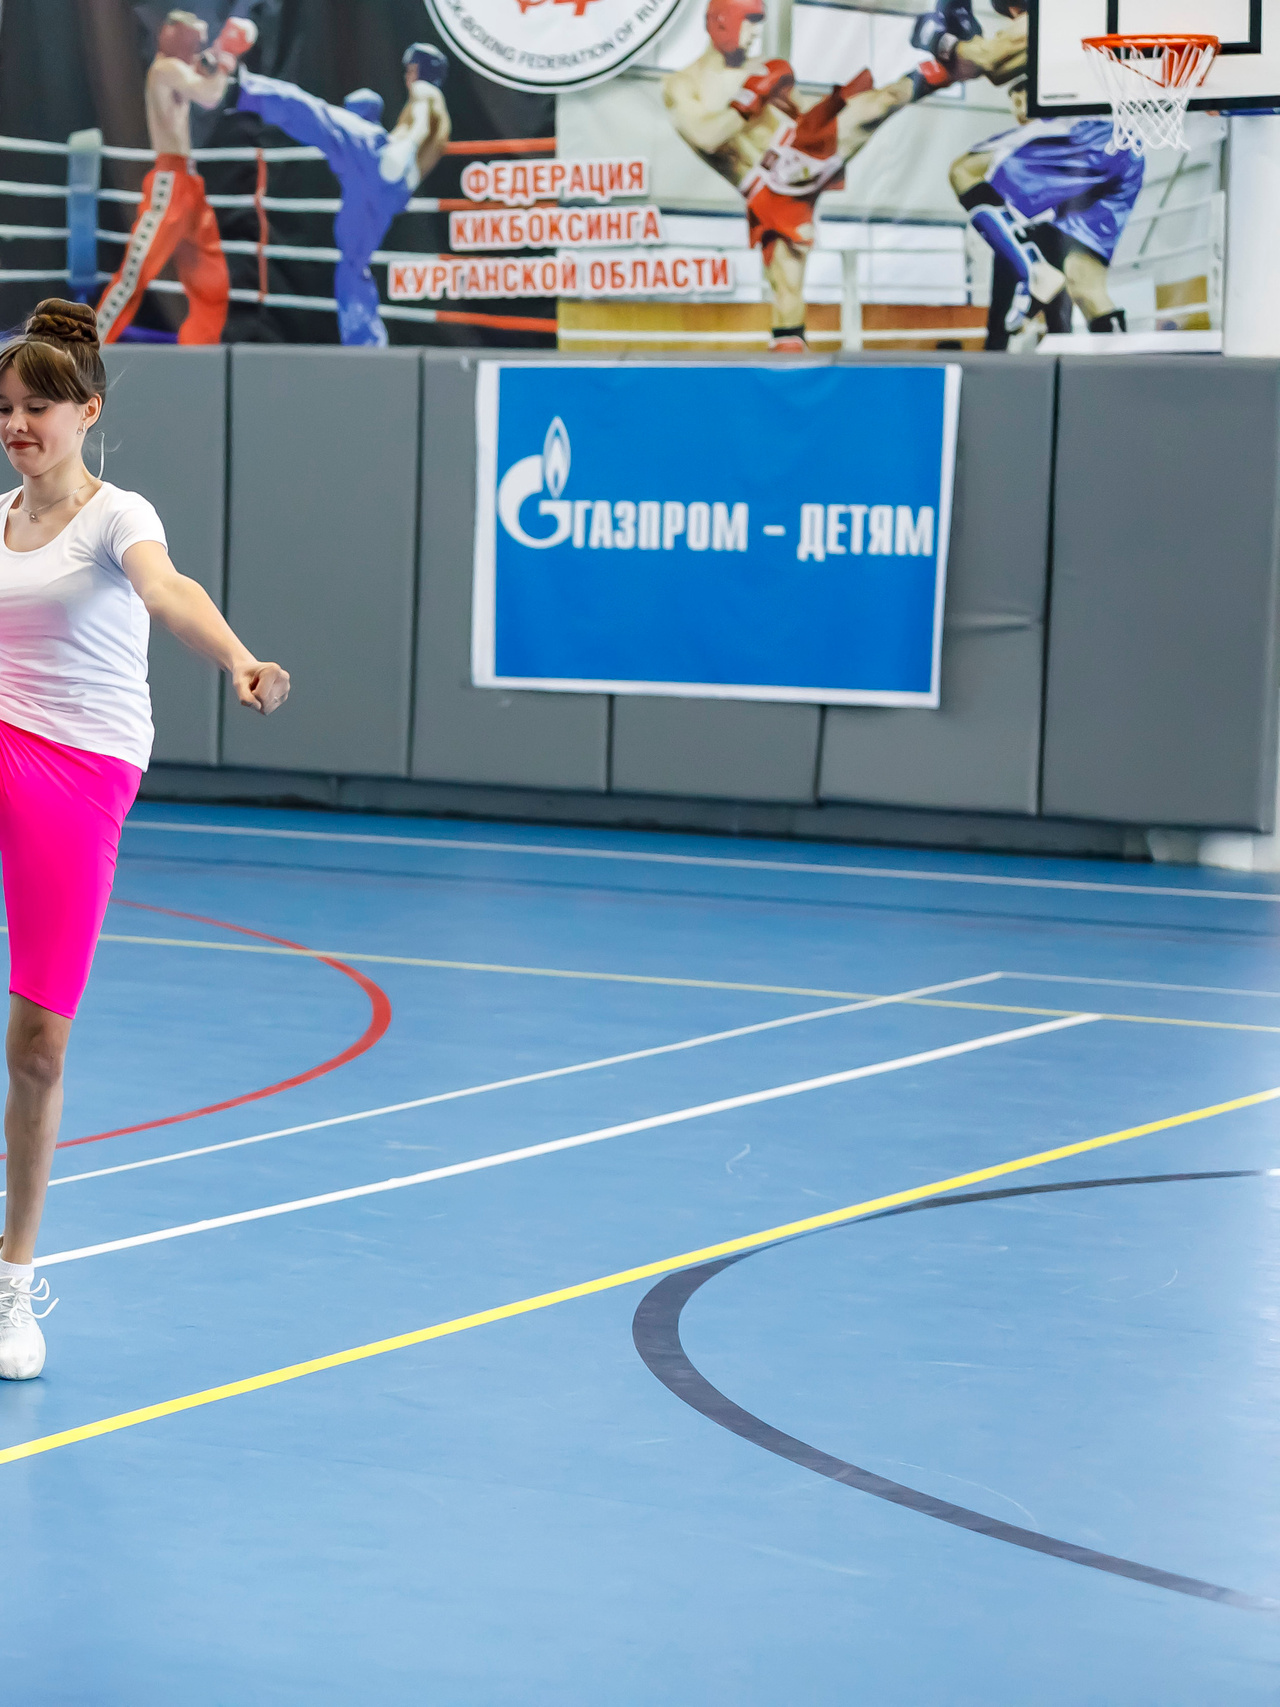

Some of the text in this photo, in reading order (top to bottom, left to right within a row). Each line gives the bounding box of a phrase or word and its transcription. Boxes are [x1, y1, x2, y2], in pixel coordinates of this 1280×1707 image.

[467, 161, 644, 199] ФЕДЕРАЦИЯ
[453, 211, 661, 244] КИКБОКСИНГА
[394, 256, 729, 294] КУРГАНСКОЙ ОБЛАСТИ
[572, 500, 749, 552] ГАЗПРОМ
[796, 503, 935, 562] ДЕТЯМ
